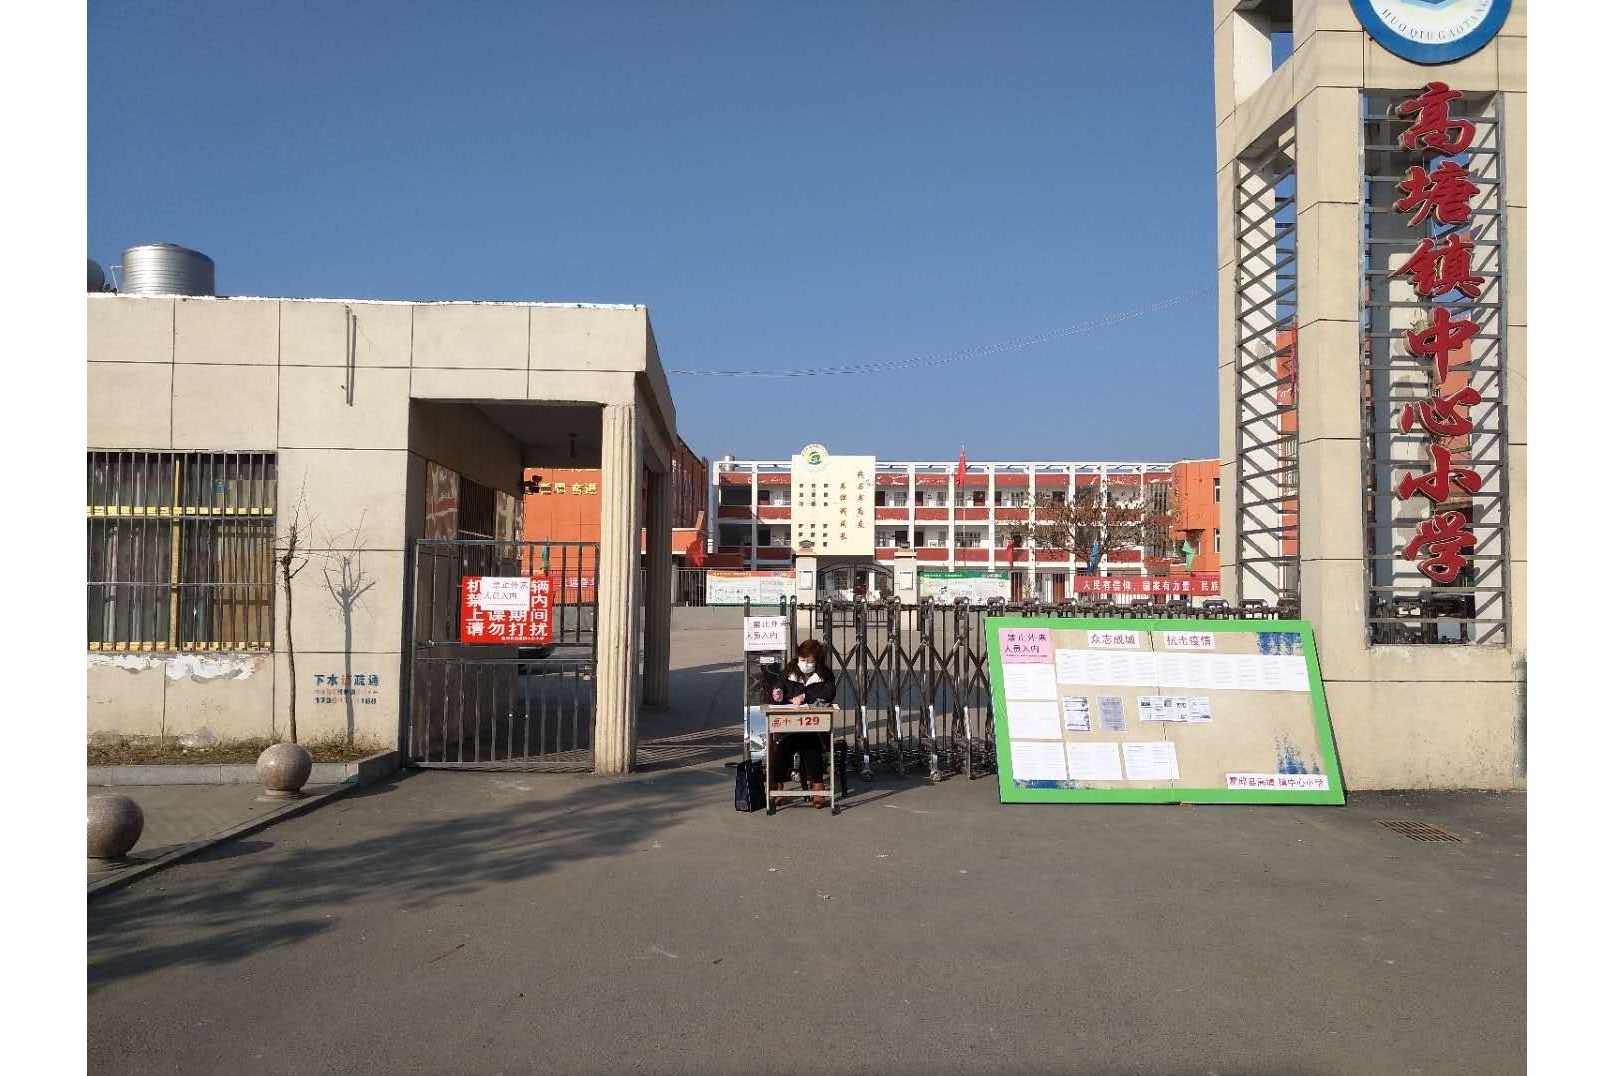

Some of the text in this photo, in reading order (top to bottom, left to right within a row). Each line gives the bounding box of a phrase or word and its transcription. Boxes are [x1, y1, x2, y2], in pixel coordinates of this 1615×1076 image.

[1388, 81, 1485, 583] 高塘镇中心小学
[465, 608, 548, 623] 上课期间
[466, 622, 549, 637] 请勿打扰
[753, 620, 788, 630] 禁止外
[1090, 633, 1136, 646] 众志成城
[1166, 635, 1212, 647] 抗击疫情
[1004, 644, 1040, 654] 人员入内
[797, 716, 820, 727] 129
